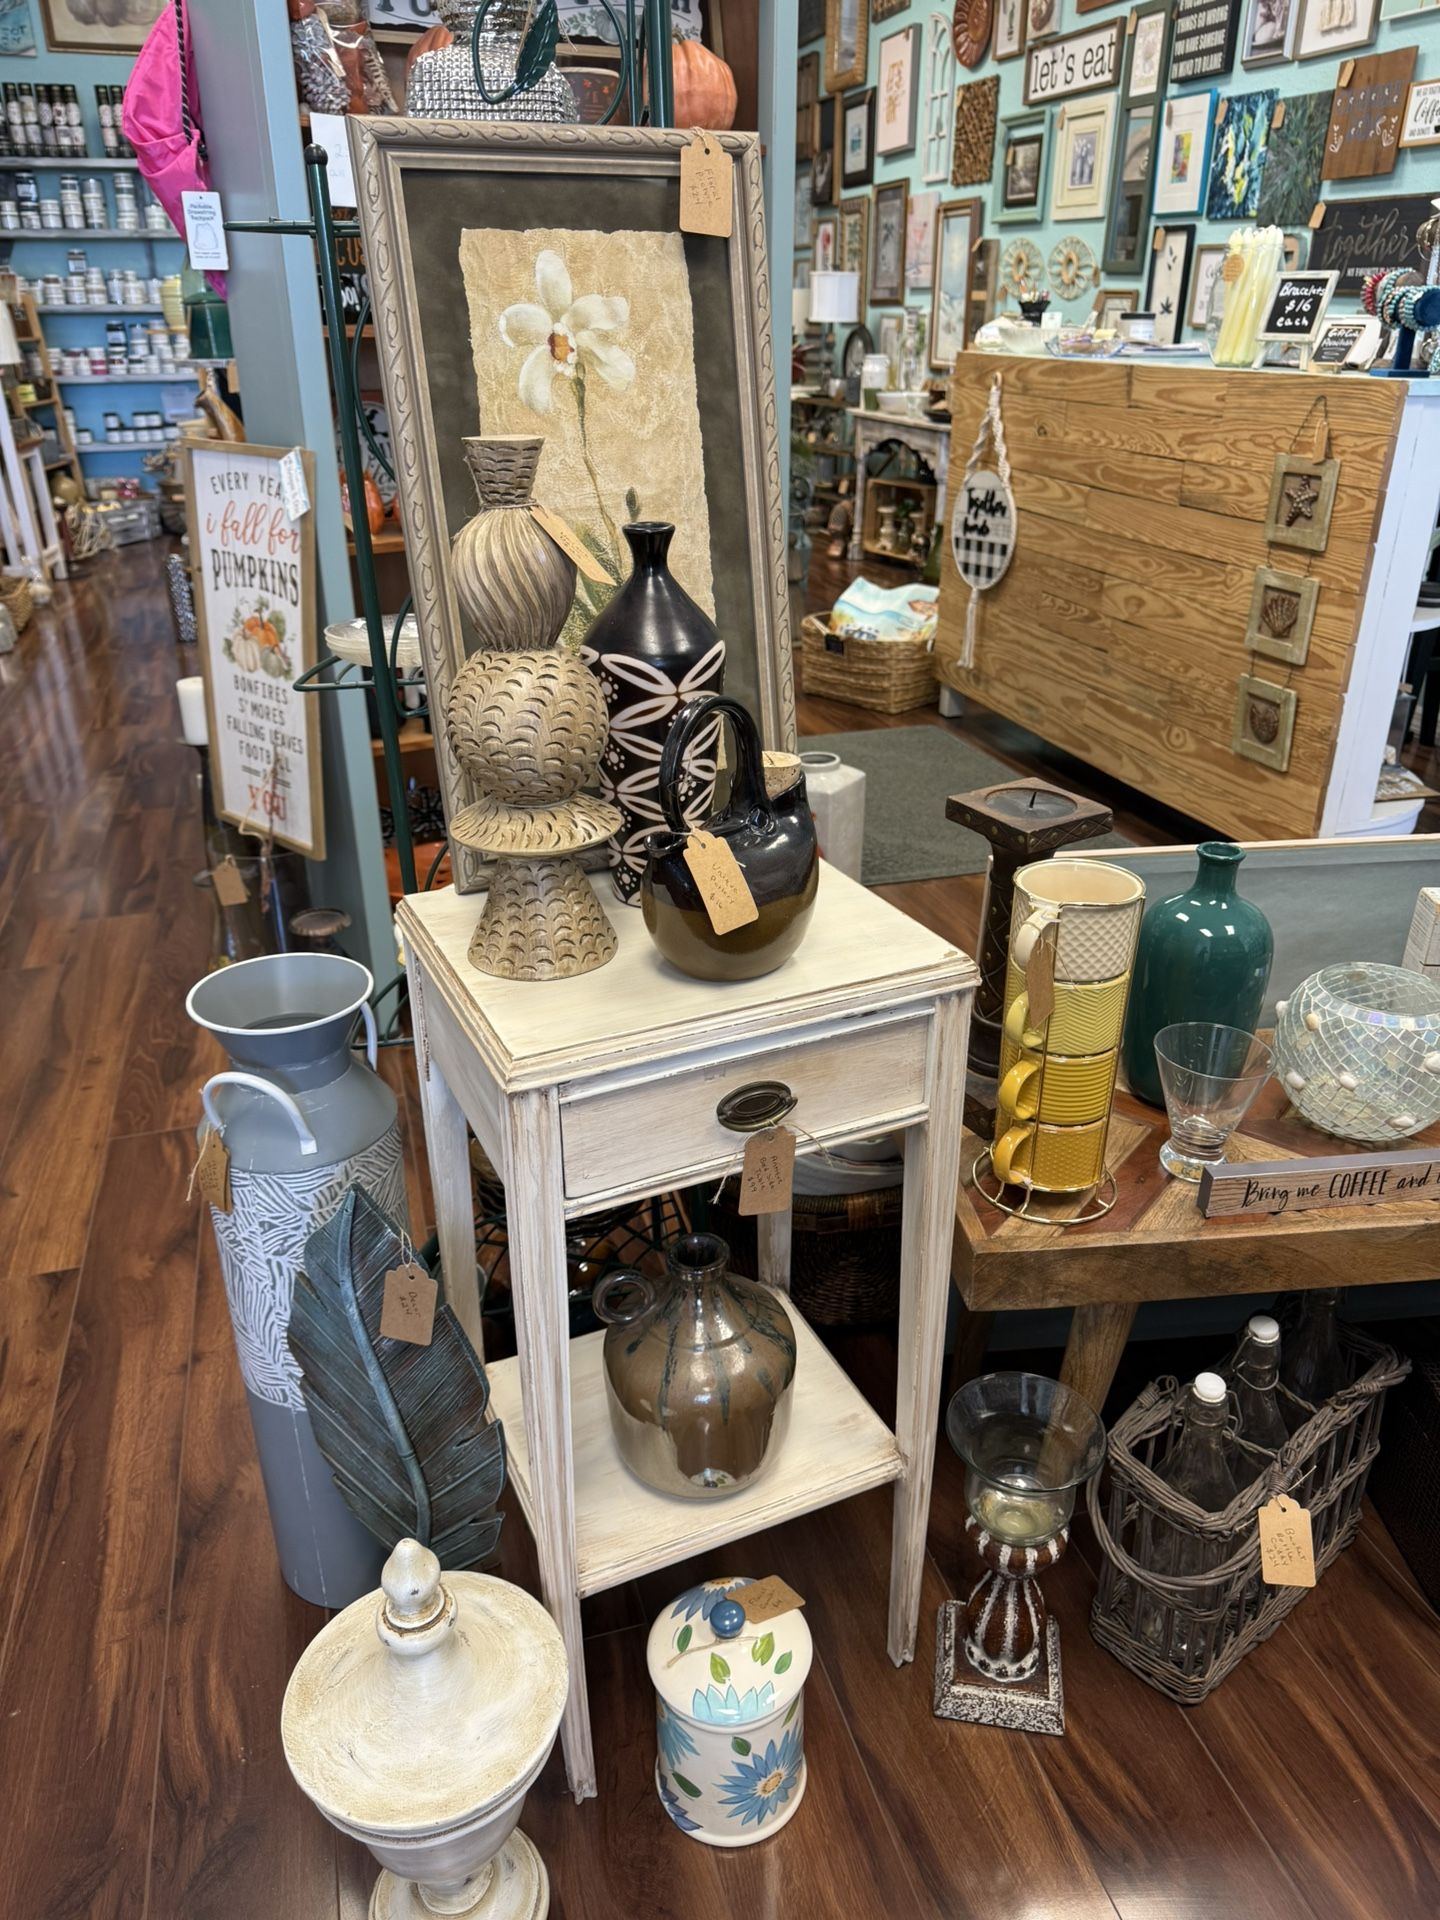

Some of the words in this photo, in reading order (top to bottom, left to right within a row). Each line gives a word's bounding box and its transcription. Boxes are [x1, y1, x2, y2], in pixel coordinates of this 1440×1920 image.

[1177, 13, 1198, 34] THINGS
[1198, 11, 1206, 28] GO
[1206, 4, 1229, 26] WRONG
[1175, 40, 1185, 56] YOU
[1185, 36, 1199, 53] HAVE
[1199, 29, 1226, 50] SOMEONE
[1032, 46, 1075, 94] let's
[1082, 33, 1116, 80] eat
[1178, 59, 1194, 78] MIND
[1194, 56, 1202, 75] TO
[1202, 52, 1223, 73] BLAME
[1314, 208, 1418, 277] together
[1279, 281, 1328, 297] Bracelets
[1276, 316, 1309, 327] each
[1285, 299, 1312, 314] $16
[210, 472, 249, 495] EVERY
[258, 474, 286, 503] YEA
[221, 500, 267, 547] fall
[268, 507, 302, 556] for
[211, 548, 299, 608] PUMPKINS
[234, 675, 288, 705] BONFIRES
[238, 698, 286, 726] S'MORES
[227, 715, 266, 741] FALLING
[270, 729, 304, 755] LEAVES
[248, 784, 288, 821] YOU
[1241, 1179, 1290, 1210] Bring
[1296, 1182, 1321, 1198] me
[1328, 1168, 1391, 1199] COFFEE
[1397, 1163, 1433, 1190] and
[1285, 1527, 1307, 1561] Basket
